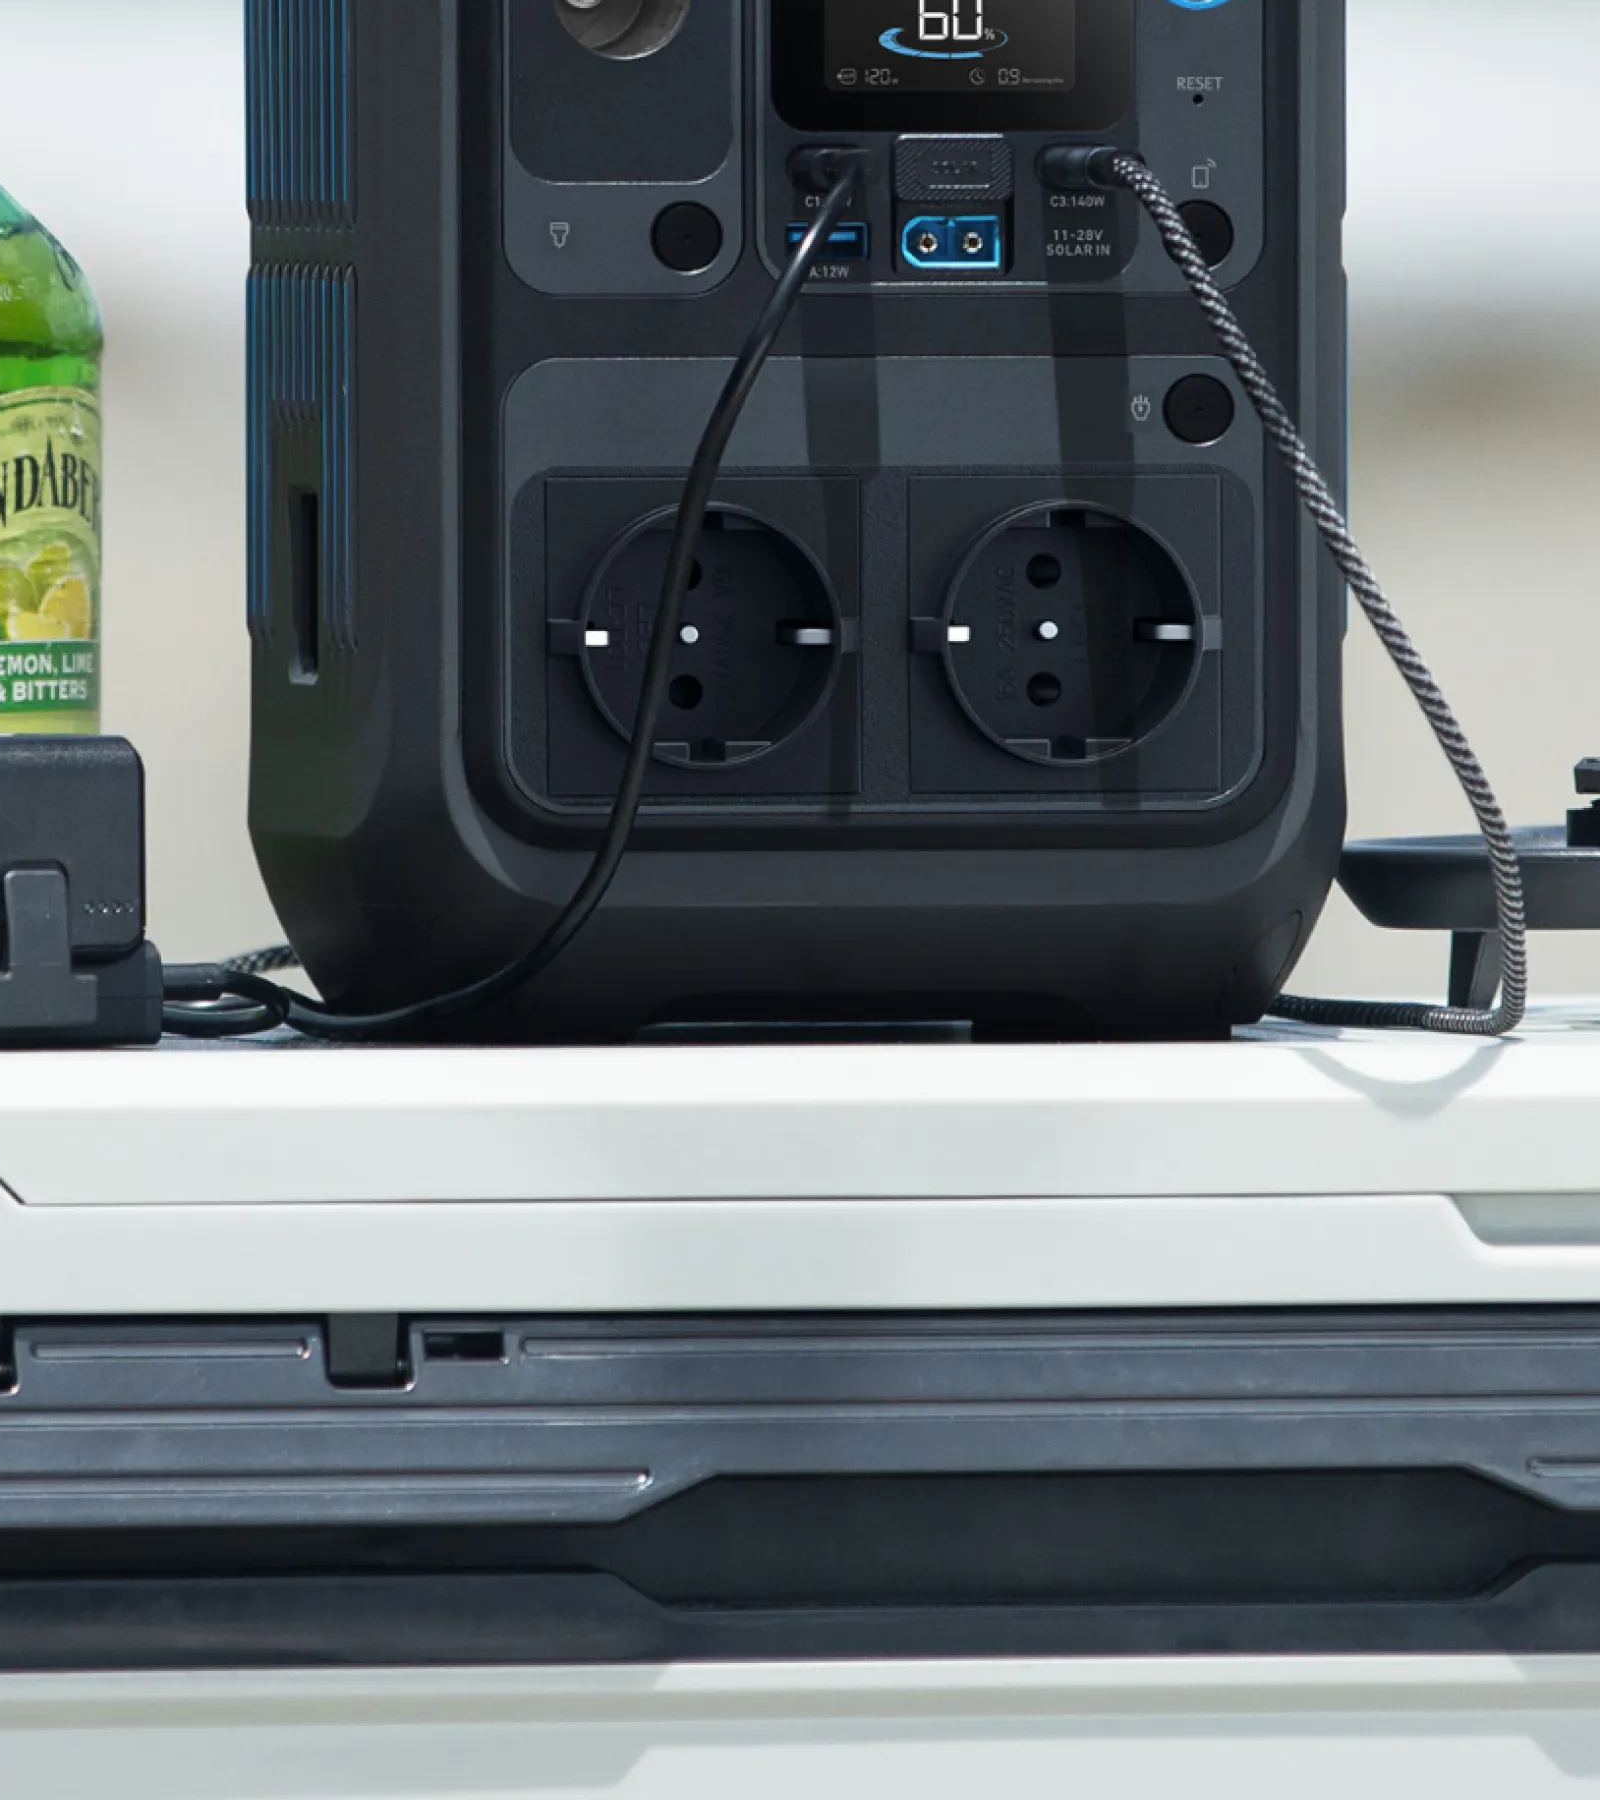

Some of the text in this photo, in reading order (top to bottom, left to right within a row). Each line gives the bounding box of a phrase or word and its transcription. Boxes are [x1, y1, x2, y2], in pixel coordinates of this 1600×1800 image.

[1176, 76, 1224, 91] RESET
[1050, 195, 1106, 208] C3:140W
[1046, 243, 1111, 257] SOLAR IN
[809, 265, 850, 278] A:12W
[994, 565, 1017, 653] 250VAC
[62, 653, 94, 673] LIME
[12, 680, 88, 702] BITTERS
